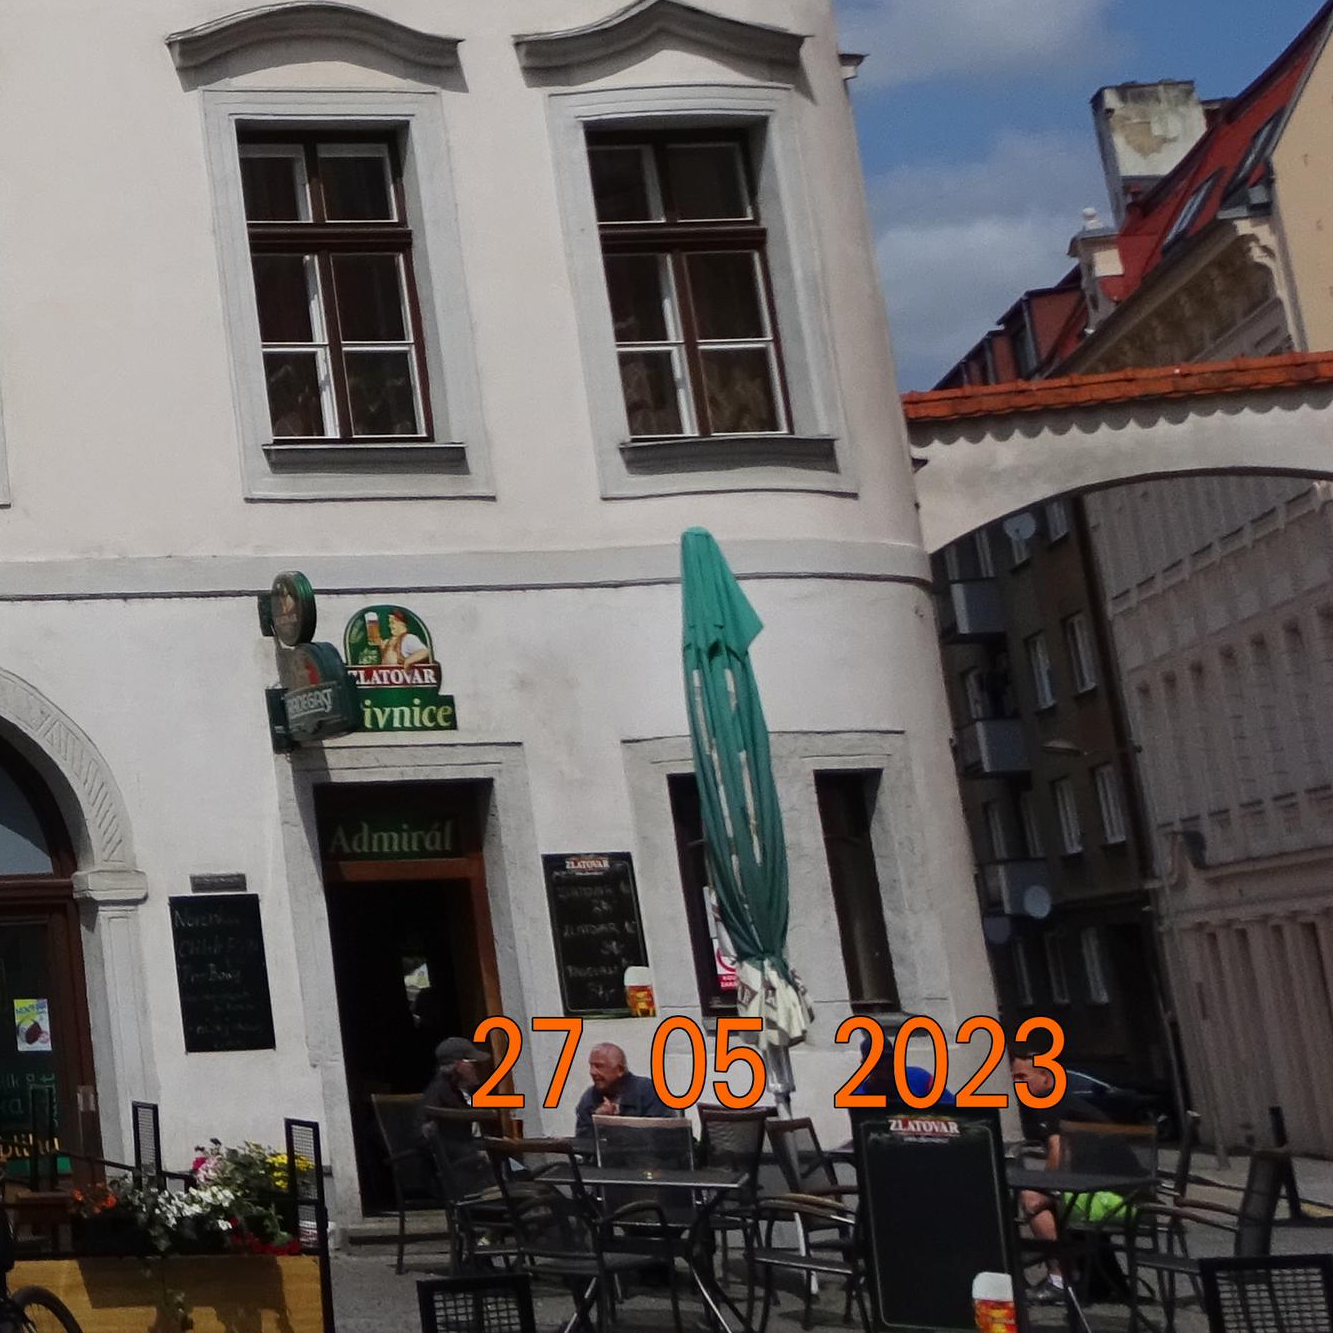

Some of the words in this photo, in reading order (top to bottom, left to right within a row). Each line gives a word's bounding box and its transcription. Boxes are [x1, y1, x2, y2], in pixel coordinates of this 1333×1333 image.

[360, 698, 453, 729] ivnice
[329, 819, 453, 854] Admirál
[888, 1119, 960, 1134] ZLATOVAR
